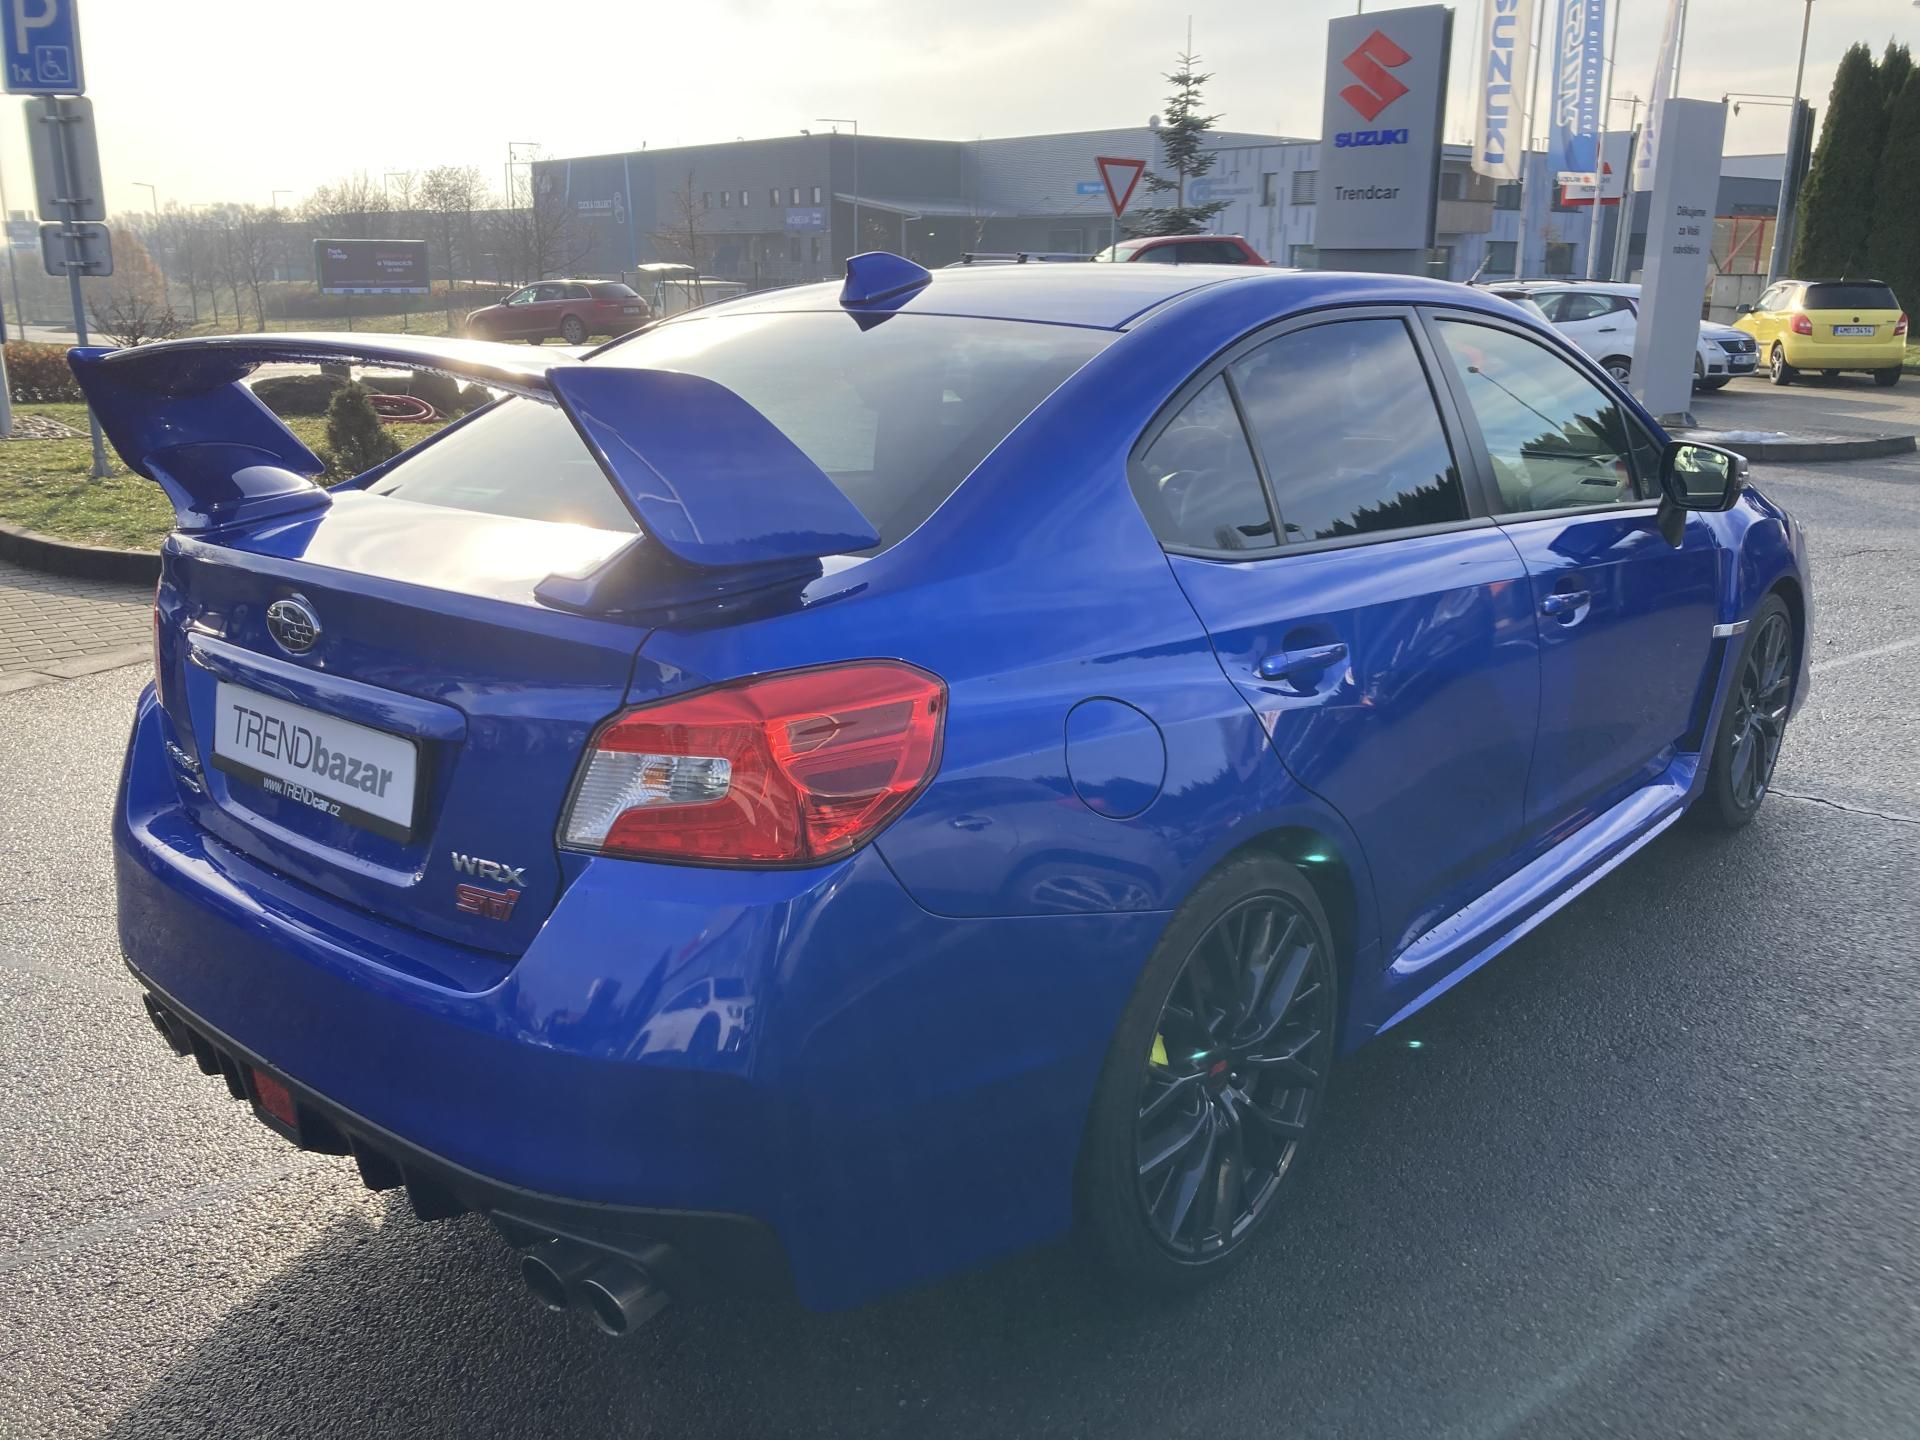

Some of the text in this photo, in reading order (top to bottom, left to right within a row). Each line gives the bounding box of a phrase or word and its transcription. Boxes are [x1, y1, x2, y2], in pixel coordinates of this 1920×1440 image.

[14, 0, 58, 54] P
[1334, 128, 1409, 148] SUZUKI
[1334, 185, 1400, 201] Trendcar
[233, 704, 393, 798] TRENDbazar
[263, 777, 341, 817] www.TRENDcar.cz
[450, 851, 528, 887] WRX
